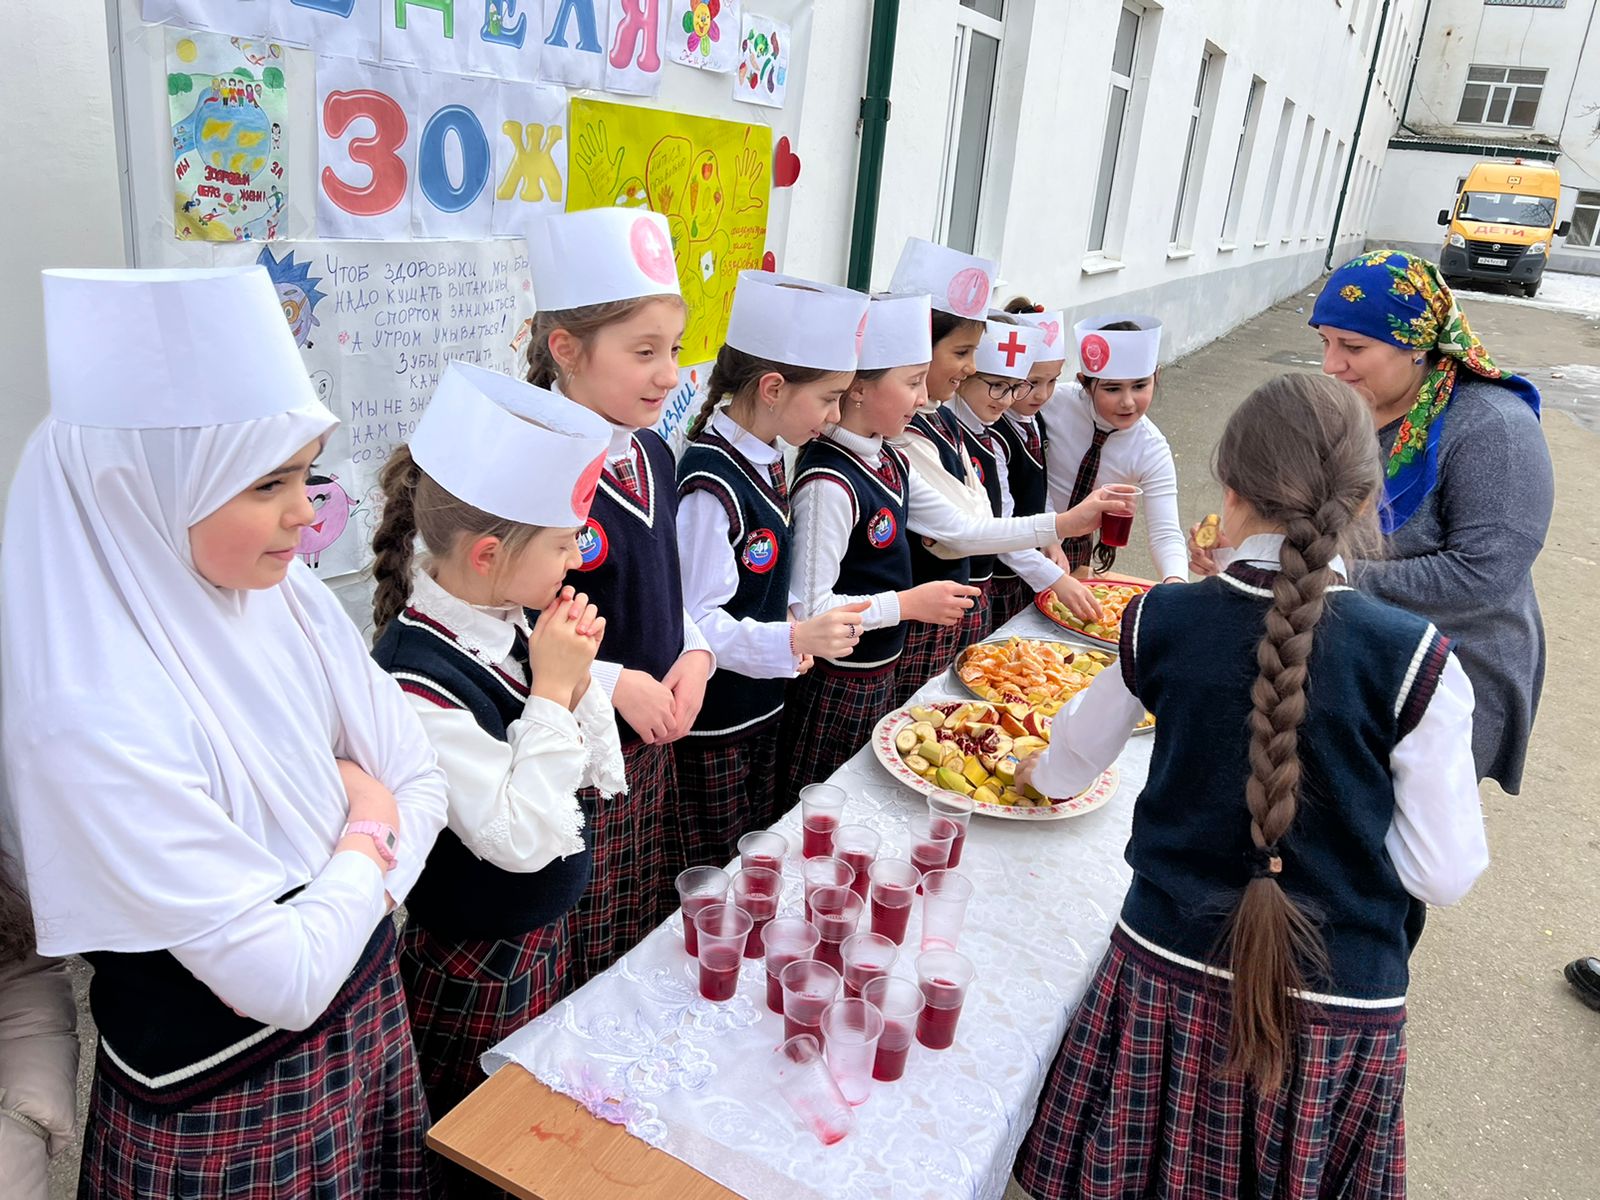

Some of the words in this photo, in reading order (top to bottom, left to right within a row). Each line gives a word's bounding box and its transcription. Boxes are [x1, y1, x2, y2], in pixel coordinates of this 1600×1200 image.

[321, 89, 563, 216] ЗОЖ
[270, 161, 284, 180] ЗА
[1474, 226, 1525, 237] ДЕТИ
[335, 290, 379, 314] НАДО
[387, 285, 443, 305] КУШАТЬ
[375, 307, 440, 327] СПОРТОМ
[351, 331, 363, 353] А
[372, 329, 422, 348] УТРОМ
[351, 399, 378, 421] МЫ
[384, 399, 403, 414] НЕ
[658, 369, 699, 440] ИЗНИ!
[352, 424, 389, 446] НАМ
